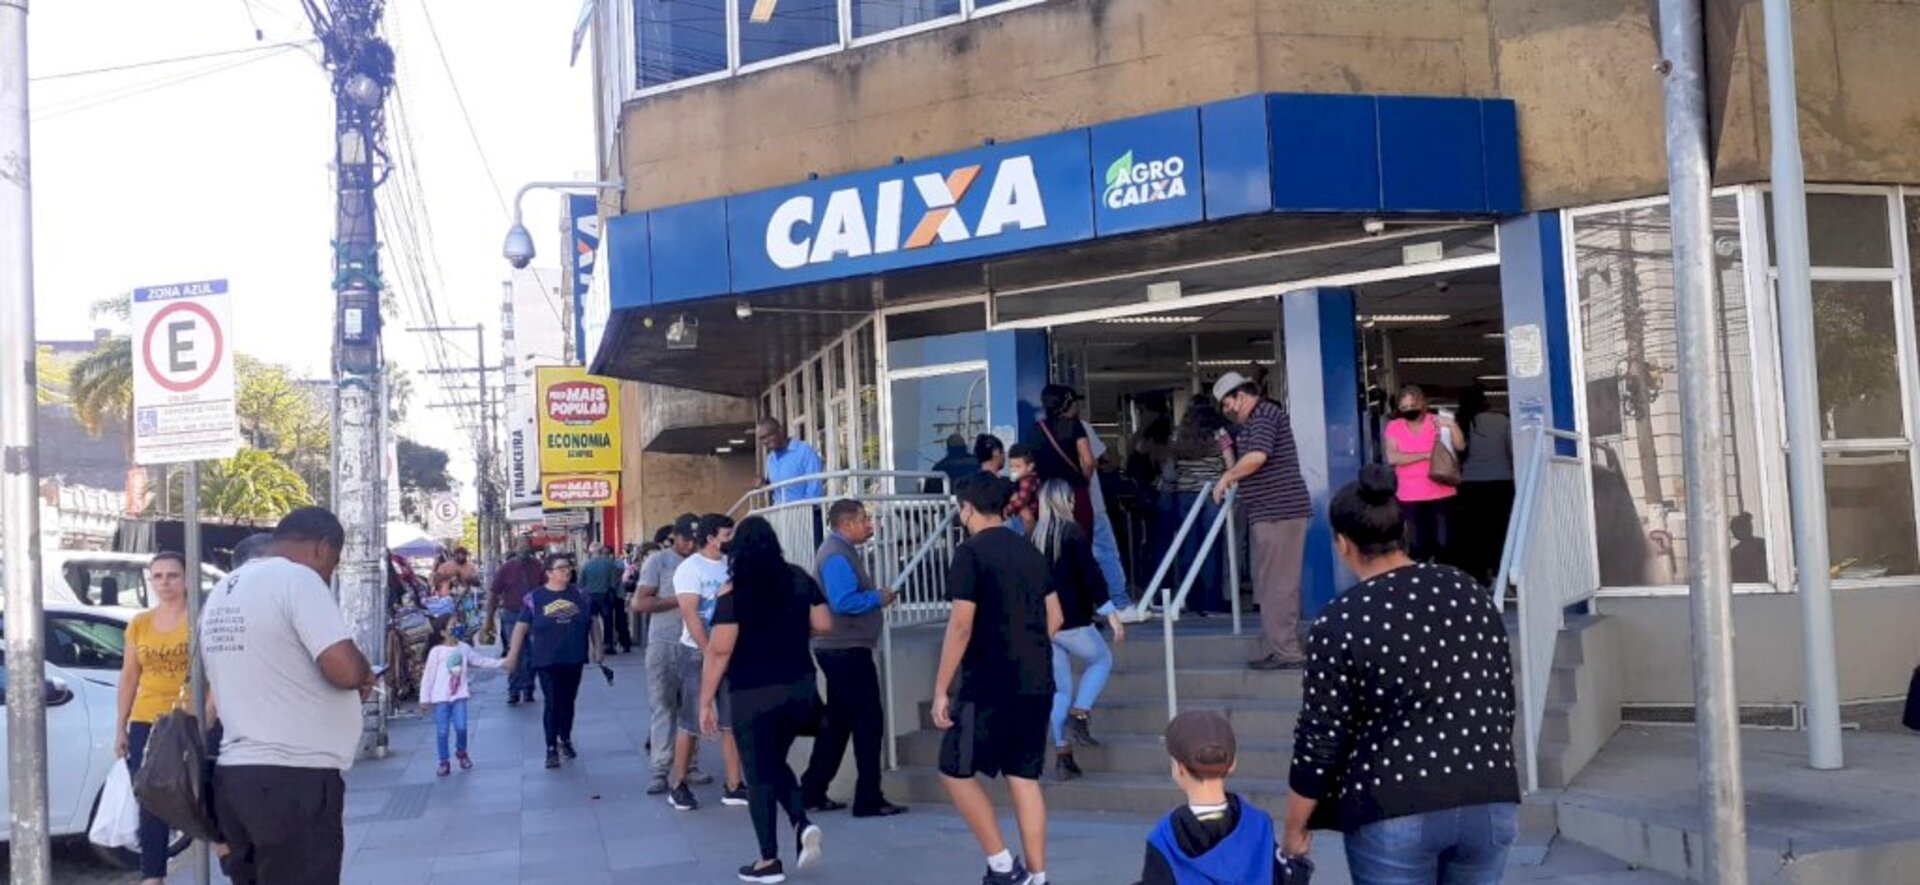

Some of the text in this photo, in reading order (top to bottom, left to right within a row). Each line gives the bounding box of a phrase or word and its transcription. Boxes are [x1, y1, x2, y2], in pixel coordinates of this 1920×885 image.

[1115, 156, 1184, 188] AGRO
[1107, 176, 1186, 209] CAIXA
[765, 155, 1047, 270] CAIXA
[577, 215, 600, 333] IXA
[147, 281, 214, 300] ZONA AZUL
[168, 320, 198, 373] E
[565, 387, 606, 401] MAIS
[550, 401, 607, 416] POPULAR
[547, 433, 612, 449] ECONOMIA
[512, 430, 526, 498] FINANCEIRA
[550, 490, 610, 500] POPULAR
[568, 481, 608, 491] MAIS
[442, 503, 452, 518] E
